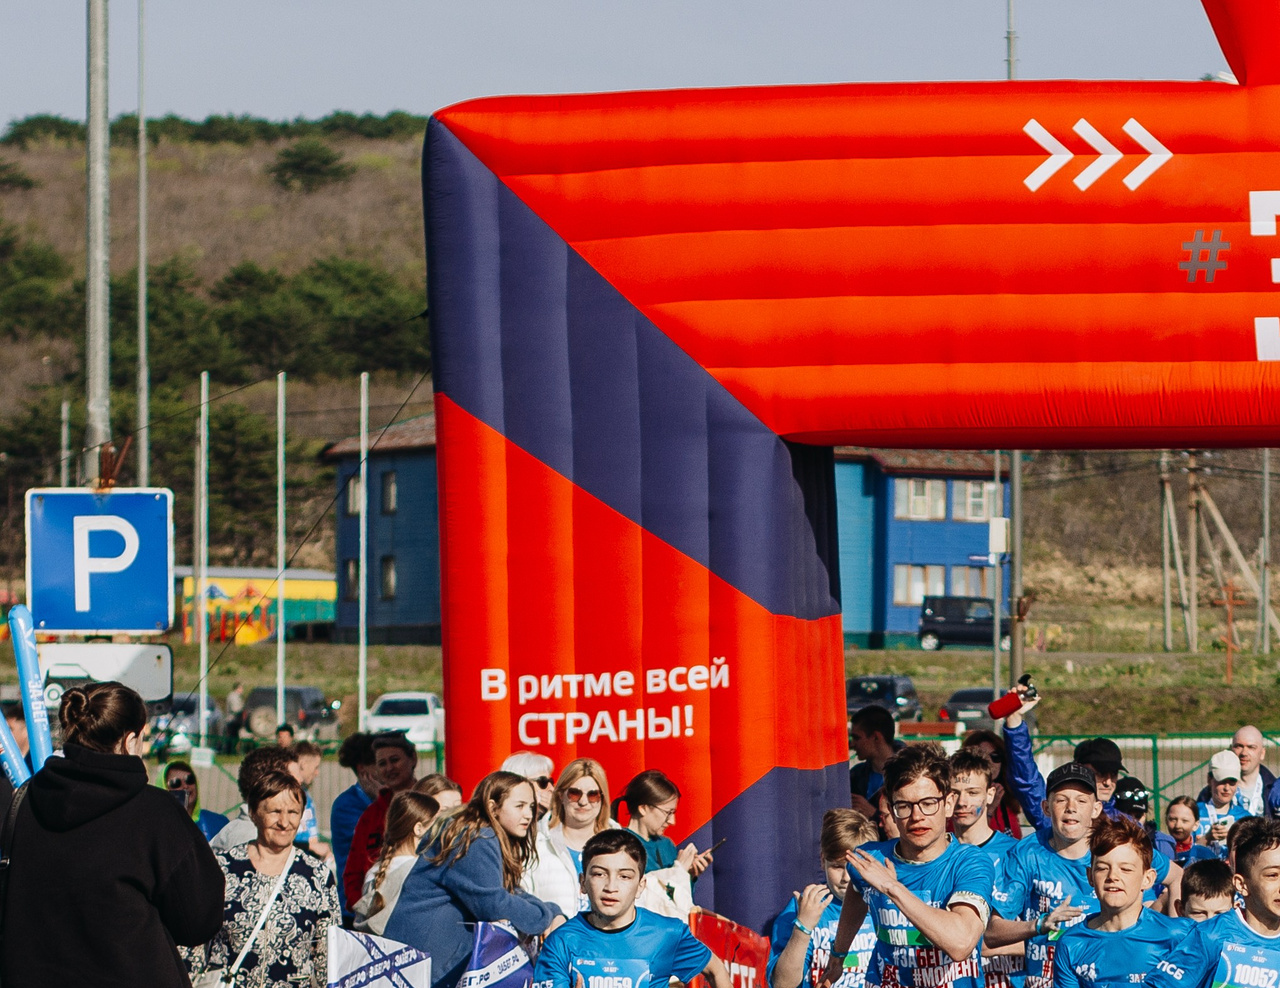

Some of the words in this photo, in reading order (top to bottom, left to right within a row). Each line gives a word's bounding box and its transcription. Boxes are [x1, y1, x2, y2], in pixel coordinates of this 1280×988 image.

[73, 515, 140, 612] P
[481, 668, 507, 701] В
[518, 669, 635, 704] ритме
[646, 656, 729, 694] всей
[518, 705, 694, 745] СТРАНЫ!
[1033, 879, 1064, 900] 2024
[912, 959, 979, 987] #МОМЕНТ
[1157, 960, 1185, 980] ПСБ
